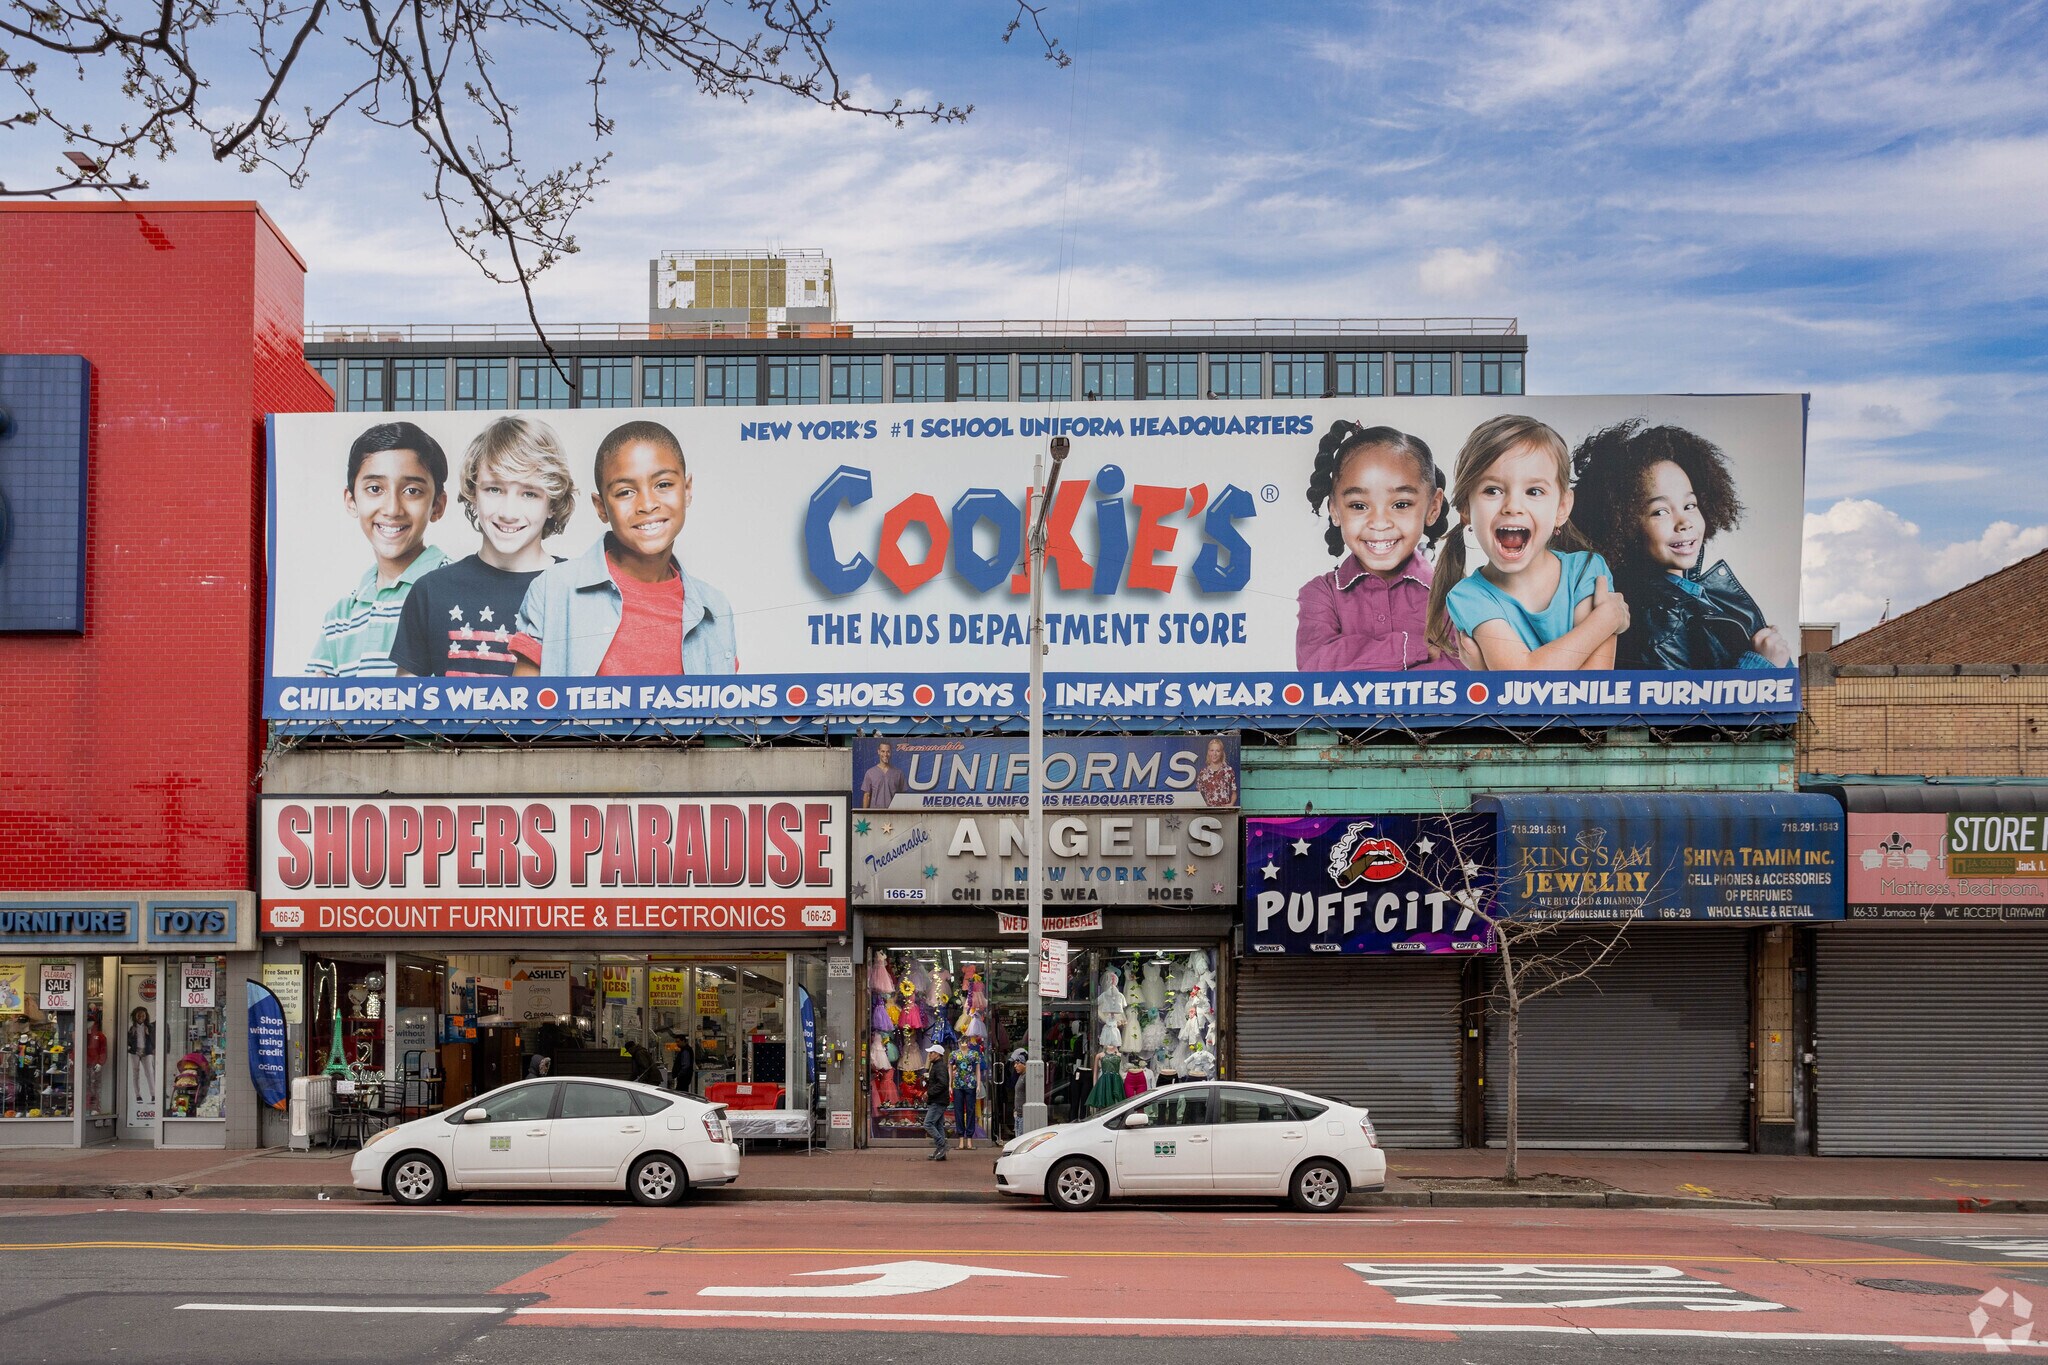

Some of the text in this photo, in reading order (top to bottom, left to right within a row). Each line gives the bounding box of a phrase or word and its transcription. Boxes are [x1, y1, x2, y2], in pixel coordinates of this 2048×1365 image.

[741, 421, 792, 441] NEW
[797, 420, 877, 440] YORK'S
[921, 417, 1013, 438] SCHOOL
[1020, 416, 1124, 437] UNIFORM
[1131, 415, 1314, 436] HEADQUARTERS
[808, 613, 862, 645] THE
[870, 612, 940, 648] KIDS
[1158, 612, 1247, 647] STORE
[279, 679, 1793, 711] CHILDREN'S WEAR TEEN FASHIONS SHOES TOYS INFANT'S WEAR LAYETTES JUVENILE FURNITURE
[908, 752, 1199, 791] UNIFORMS
[922, 794, 1174, 808] MEDICAL UNIFOMS HEADQUARTERS
[947, 817, 1224, 858] ANGELS
[1952, 817, 2038, 852] STORE
[278, 802, 833, 889] SHOPPERS PARADISE
[865, 828, 929, 872] Treasurable
[1521, 846, 1652, 867] KING SAM
[1683, 847, 1835, 866] SHIVA TAMIM INC.
[2016, 860, 2036, 871] Jack
[1014, 867, 1146, 882] NW YORK
[1688, 872, 1831, 886] CELL PHONES & ACCESSORIES
[1521, 872, 1650, 898] JEWELRY
[1957, 877, 2044, 897] Bedroom,
[886, 889, 923, 899] 166-25
[1539, 896, 1642, 906] WE BUY GOLD & DIAMOND
[1725, 889, 1792, 901] OF PERFUMES
[275, 905, 832, 928] 166-25 DISCOUNT FURNITURE & ELECTRONICS 166-25
[1257, 891, 1368, 934] PUFF
[1620, 910, 1645, 918] RETAIL
[1658, 907, 1691, 918] 166-29
[1707, 905, 1814, 918] WHOLE SALE & RETAIL
[1853, 906, 1878, 917] 166-33
[1881, 906, 1916, 917] Jamaica
[1944, 907, 1959, 918] WE
[1964, 907, 2002, 918] ACCEPT
[2006, 907, 2046, 918] LAYAWAY
[156, 911, 225, 932] TOYS
[1003, 917, 1017, 930] WE
[44, 971, 73, 979] CLEARANCE
[184, 969, 212, 977] CLEARANCE
[528, 970, 567, 979] ASHLEY
[48, 980, 68, 991] SALE
[188, 978, 208, 989] SALE
[260, 1016, 283, 1027] Shop
[250, 1027, 284, 1036] without
[259, 1038, 283, 1047] using
